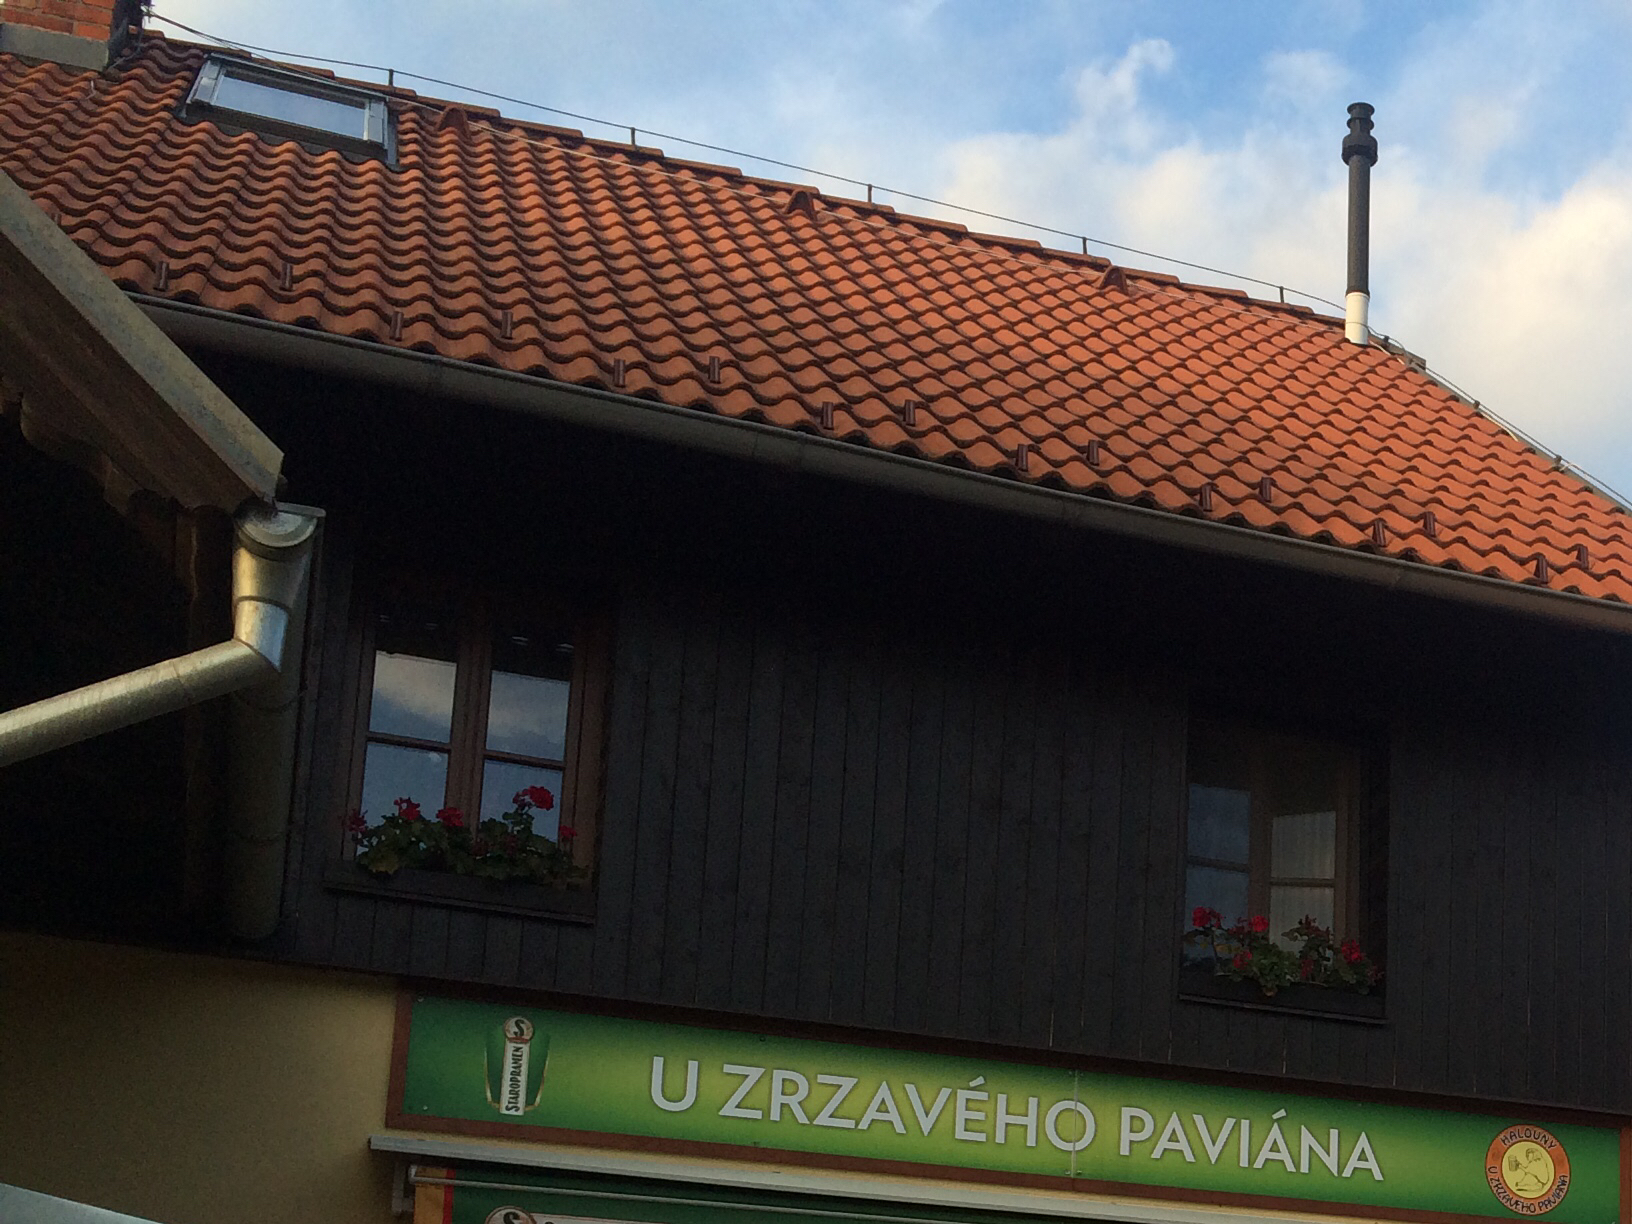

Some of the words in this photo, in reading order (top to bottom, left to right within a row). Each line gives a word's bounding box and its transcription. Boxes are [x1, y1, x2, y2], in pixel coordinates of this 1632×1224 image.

[505, 1045, 524, 1112] STAROPRAMEN
[650, 1056, 699, 1112] U
[719, 1063, 1096, 1151] ZRZAVÉHO
[1119, 1108, 1384, 1181] PAVIÁNA
